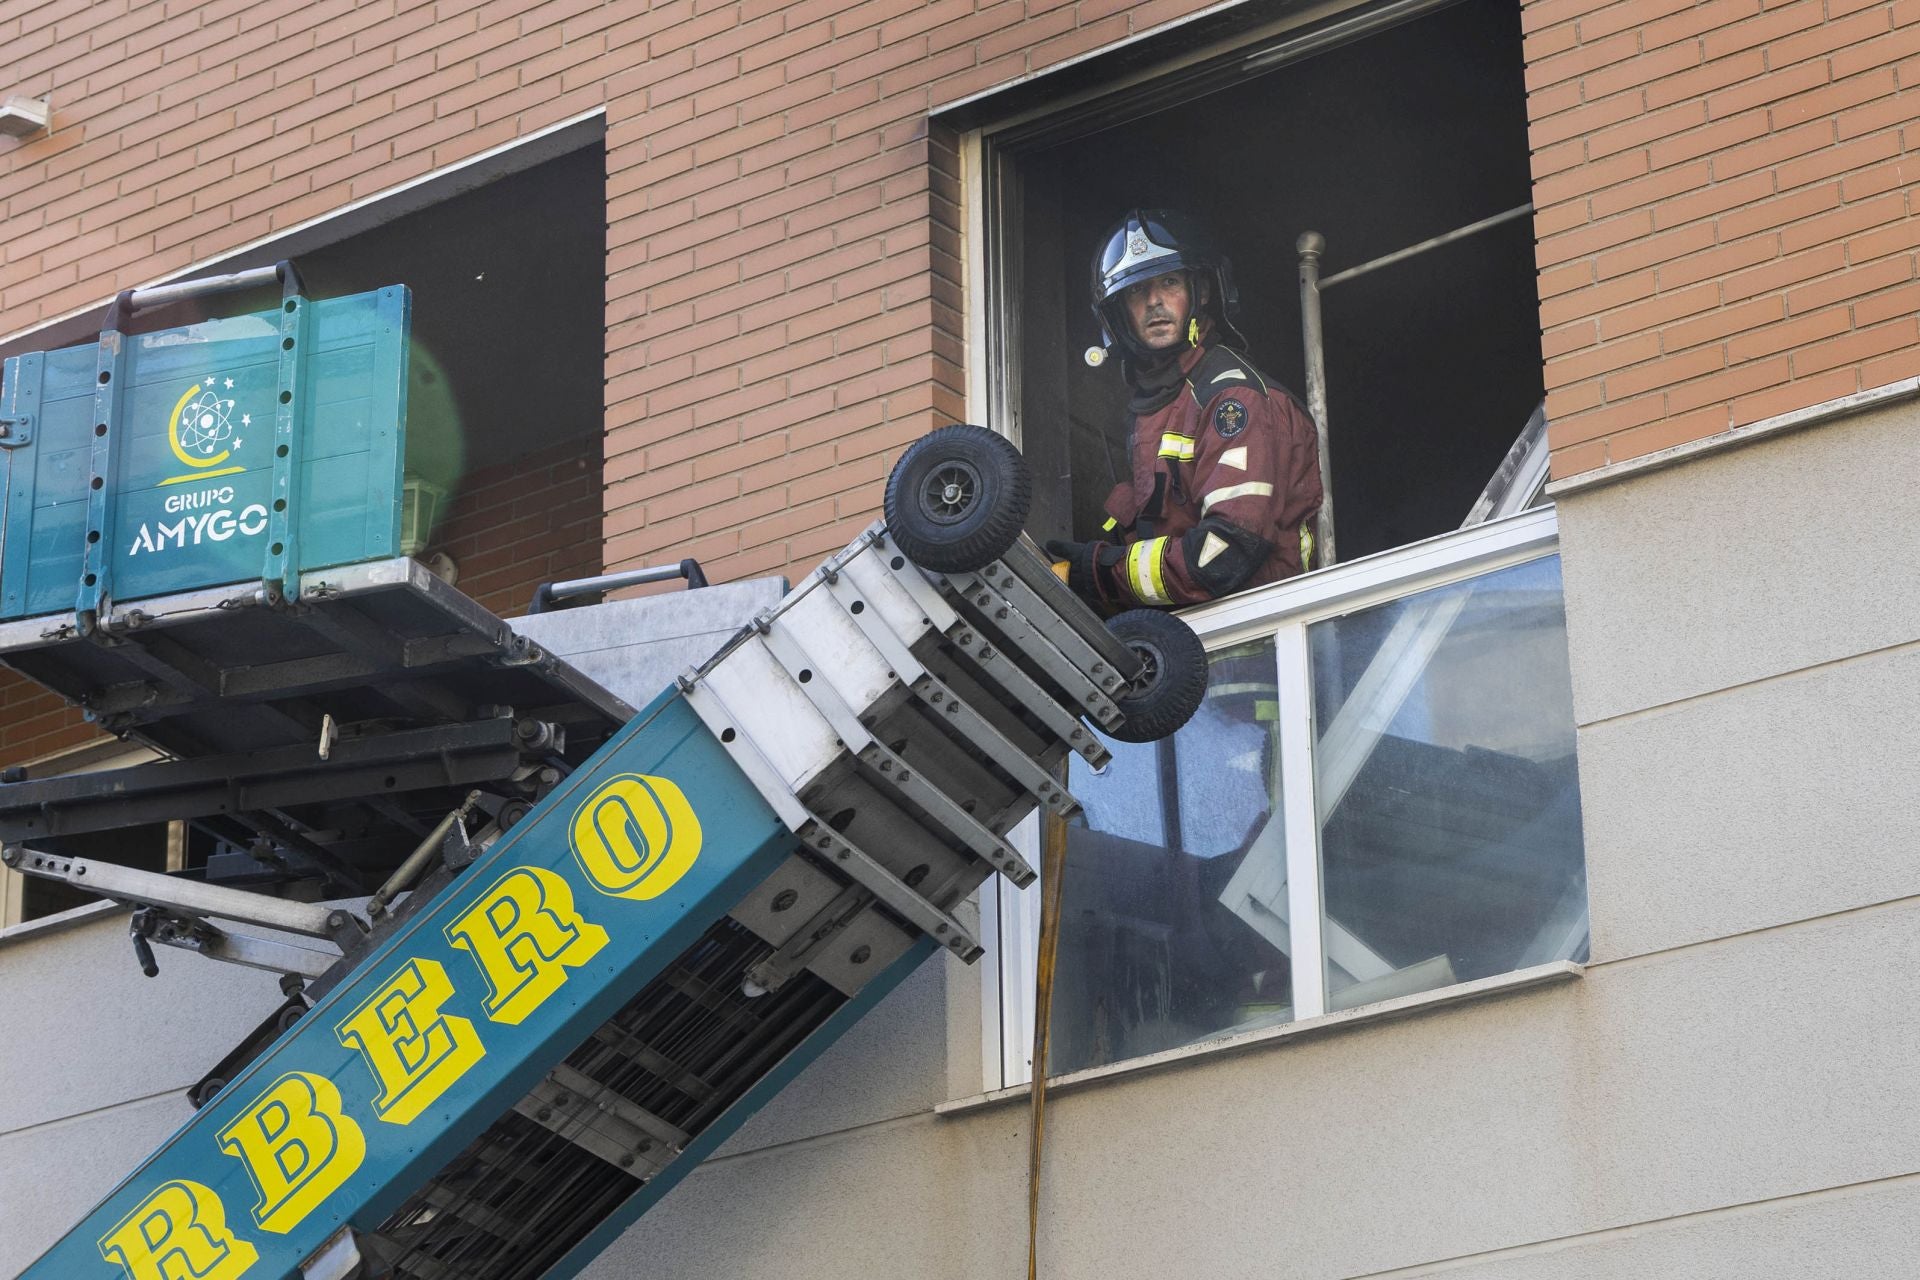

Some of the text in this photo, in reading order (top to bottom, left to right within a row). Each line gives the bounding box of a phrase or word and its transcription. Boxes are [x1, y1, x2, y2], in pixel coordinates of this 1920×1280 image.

[164, 486, 234, 513] GRUPO
[129, 503, 268, 556] AMYGO
[97, 772, 704, 1280] RBERO
